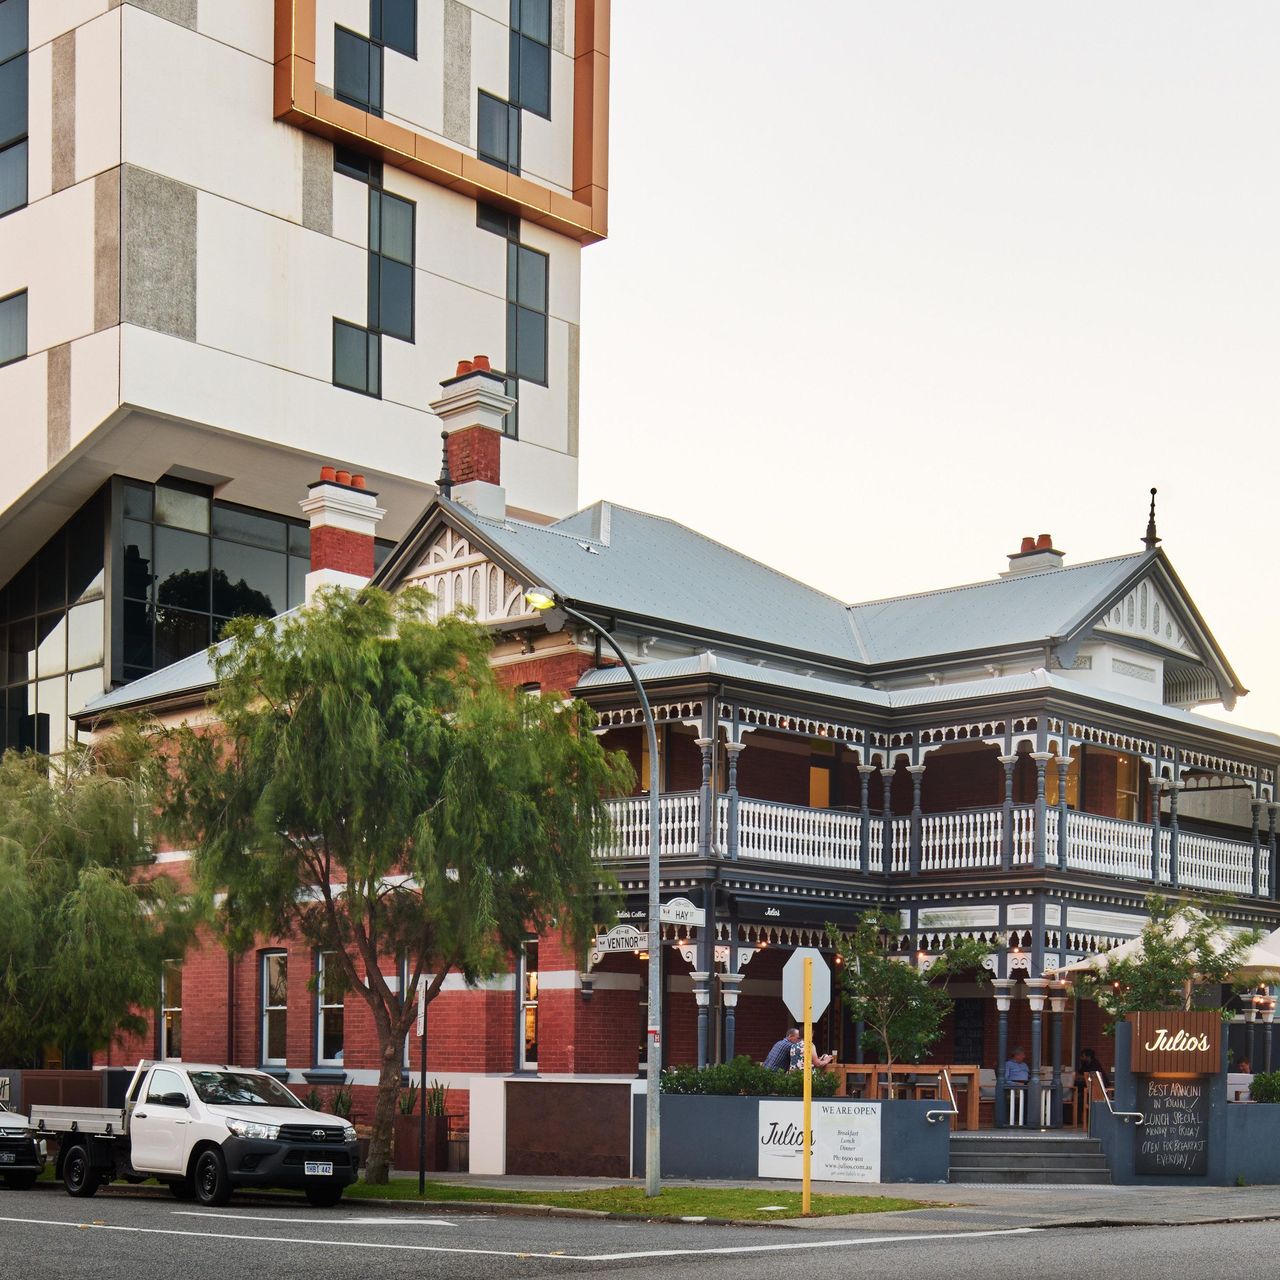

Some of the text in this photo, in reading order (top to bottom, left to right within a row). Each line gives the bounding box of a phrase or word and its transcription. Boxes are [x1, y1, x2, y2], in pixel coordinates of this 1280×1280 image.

[676, 910, 689, 920] HAY
[607, 936, 639, 949] VENTNOR
[1145, 1029, 1210, 1052] Julio's
[1148, 1081, 1169, 1097] BEST
[822, 1106, 877, 1115] WE ARE OPEN
[1153, 1099, 1161, 1109] IN
[1144, 1111, 1204, 1126] LUNCH SPECIAL
[1141, 1140, 1160, 1154] OPEN
